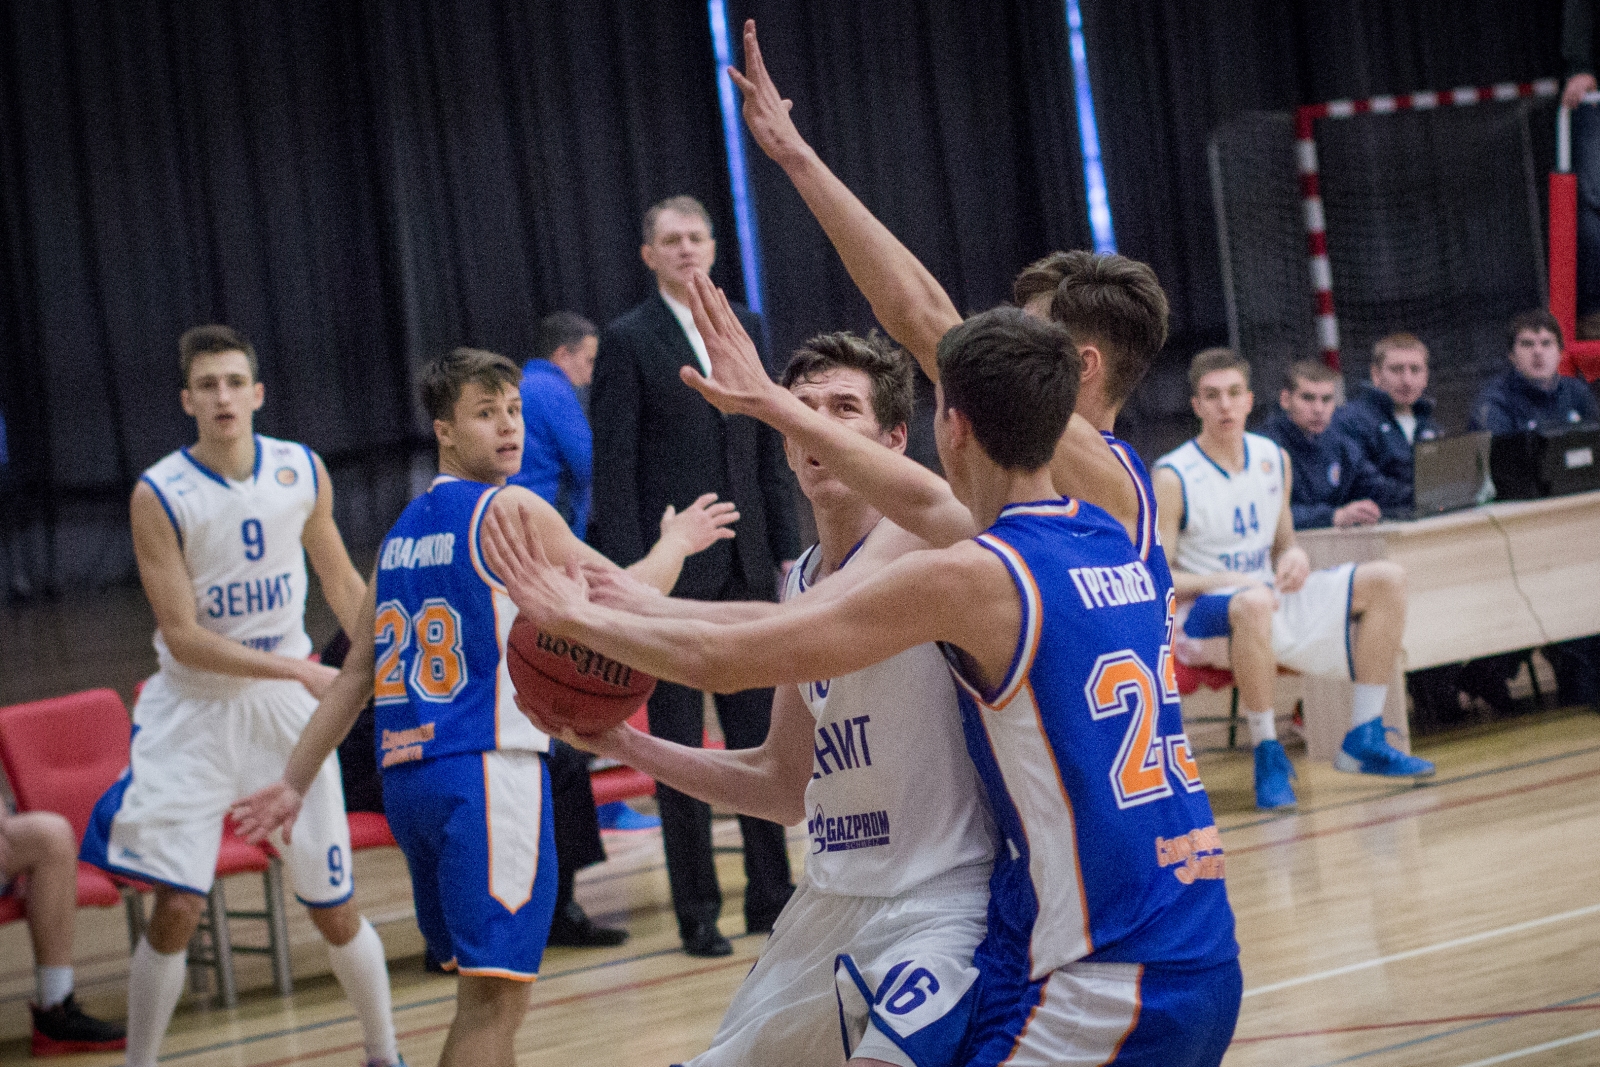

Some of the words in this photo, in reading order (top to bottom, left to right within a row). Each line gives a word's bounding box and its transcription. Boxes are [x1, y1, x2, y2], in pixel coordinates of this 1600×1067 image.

[240, 518, 266, 561] 9
[1233, 502, 1260, 537] 44
[1218, 546, 1270, 573] ЗЕНИ
[206, 571, 292, 619] ЗЕНИТ
[374, 597, 469, 706] 28
[813, 715, 872, 780] НИТ
[825, 810, 890, 842] GAZPROM
[327, 844, 345, 887] 9
[875, 959, 941, 1016] 16
